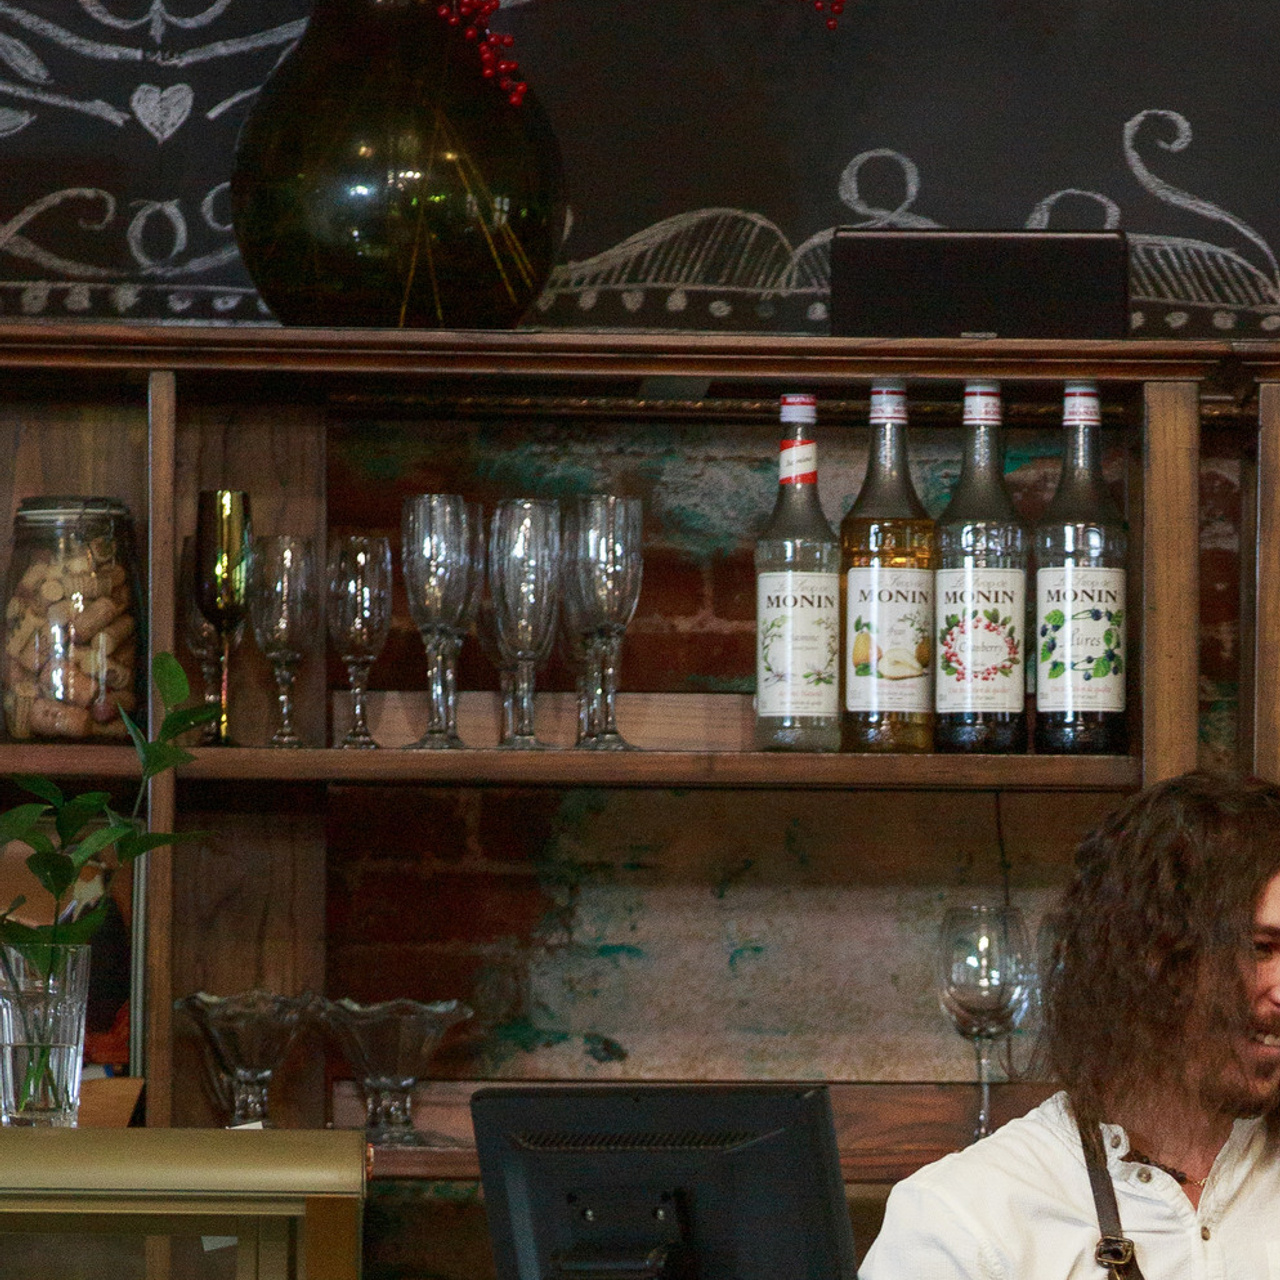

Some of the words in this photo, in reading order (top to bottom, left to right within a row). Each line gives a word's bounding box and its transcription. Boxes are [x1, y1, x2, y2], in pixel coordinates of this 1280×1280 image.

[766, 595, 835, 609] MONIN
[858, 589, 930, 604] MONIN
[944, 590, 1015, 604] MONIN
[1046, 589, 1118, 603] MONIN
